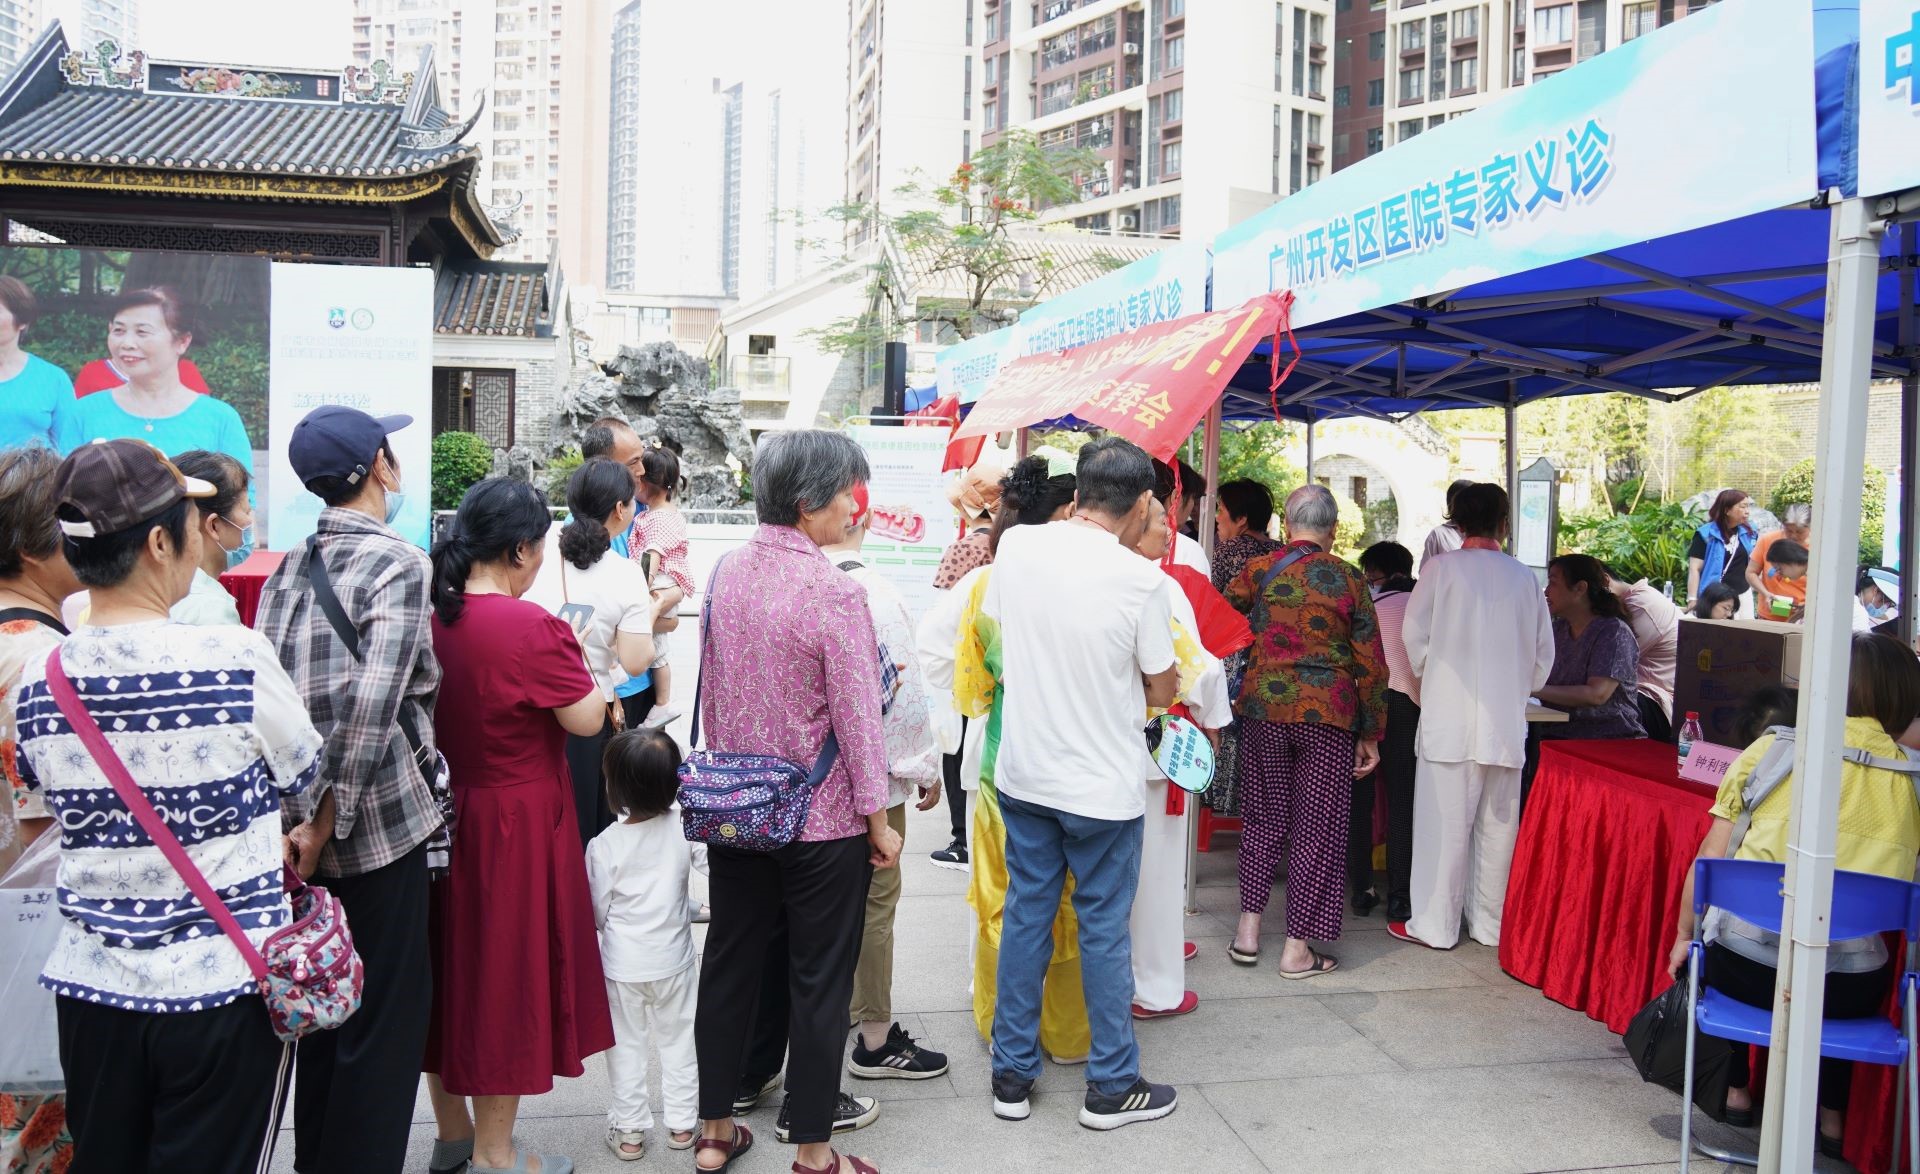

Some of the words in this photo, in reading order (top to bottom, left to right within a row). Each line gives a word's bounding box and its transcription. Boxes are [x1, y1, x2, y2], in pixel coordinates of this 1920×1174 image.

[1268, 119, 1610, 293] 广州开发区医院专家义诊
